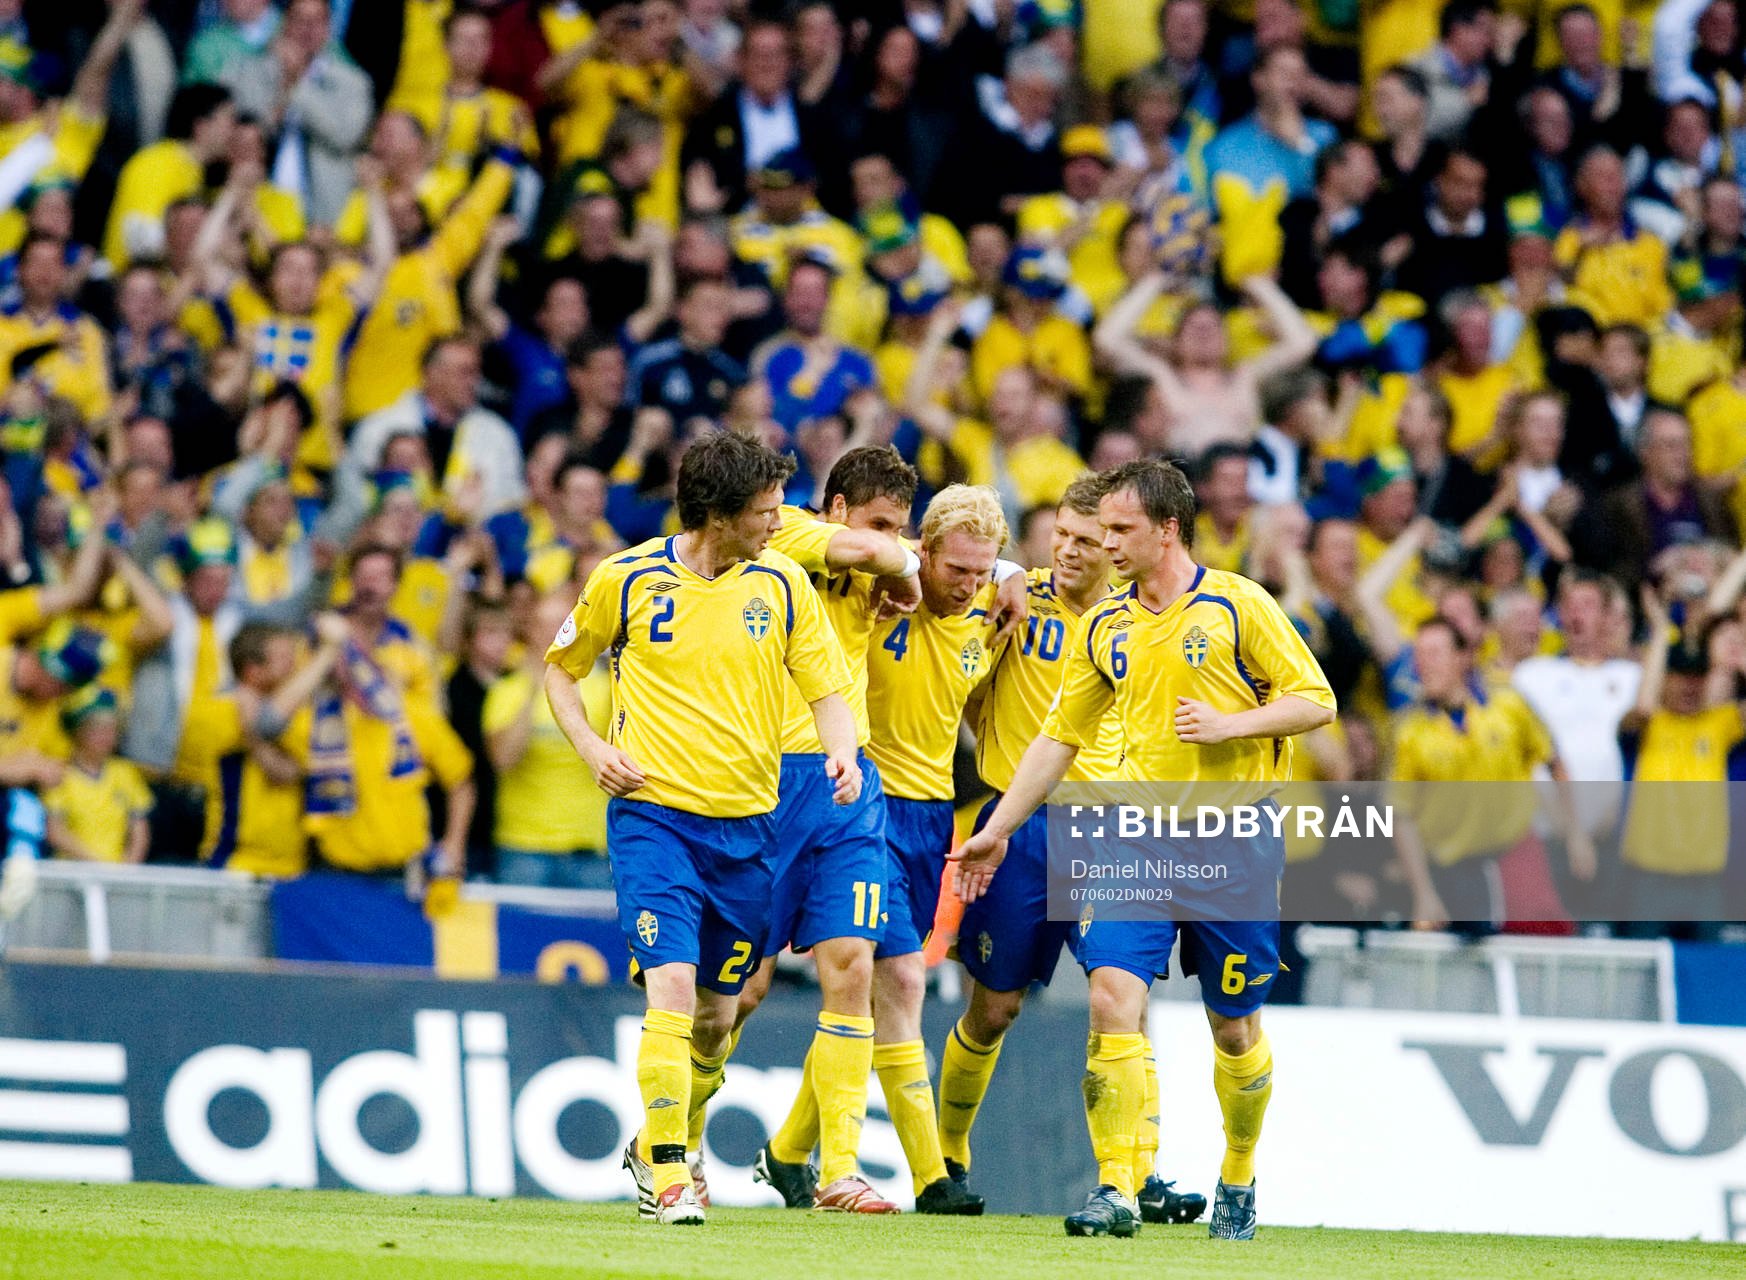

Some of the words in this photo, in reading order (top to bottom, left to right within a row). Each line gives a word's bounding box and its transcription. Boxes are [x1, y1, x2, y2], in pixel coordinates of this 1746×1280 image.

[649, 594, 675, 643] 2
[883, 616, 911, 662] 4
[1022, 614, 1065, 662] 10
[1110, 631, 1129, 680] 6
[852, 881, 881, 929] 11
[718, 940, 752, 984] 2
[1221, 953, 1248, 996] 6
